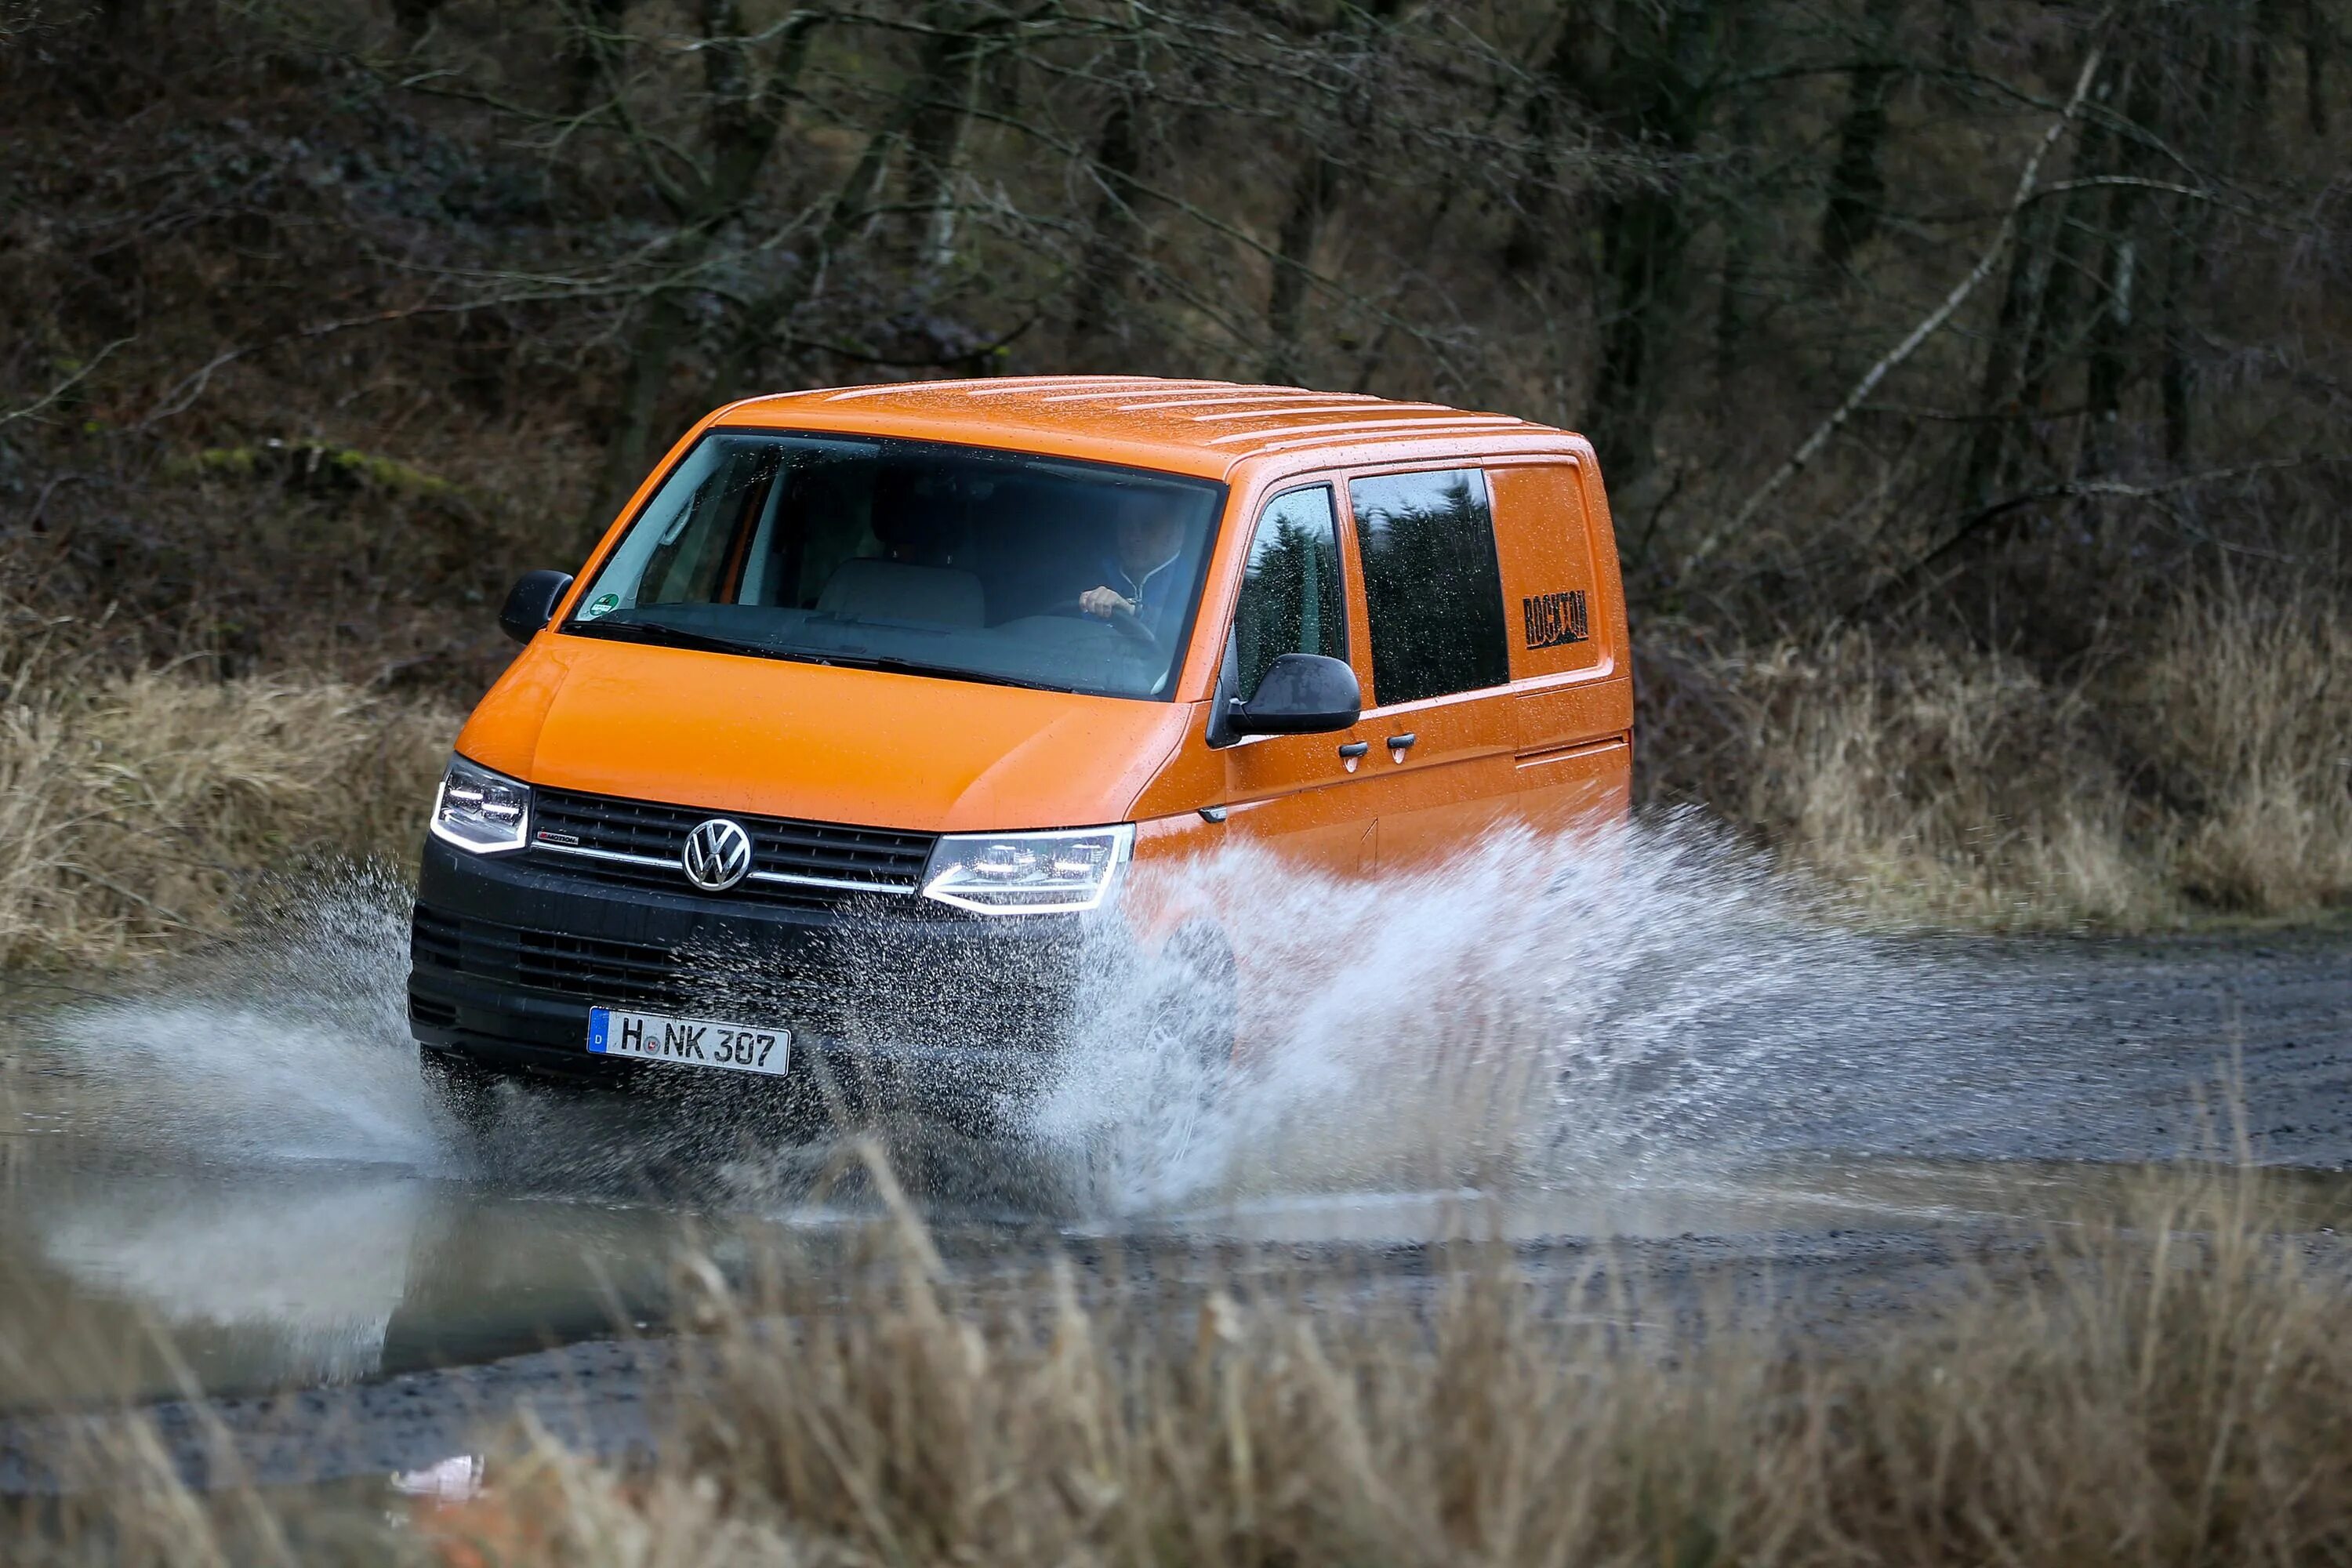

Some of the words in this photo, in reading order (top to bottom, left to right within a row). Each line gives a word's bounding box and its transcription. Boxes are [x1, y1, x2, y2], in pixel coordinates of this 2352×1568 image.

[1523, 590, 1588, 647] ROCKTON
[683, 818, 751, 891] VW
[594, 1034, 602, 1044] D
[622, 1018, 644, 1051] H
[663, 1022, 707, 1059] NK
[713, 1029, 775, 1067] 307
